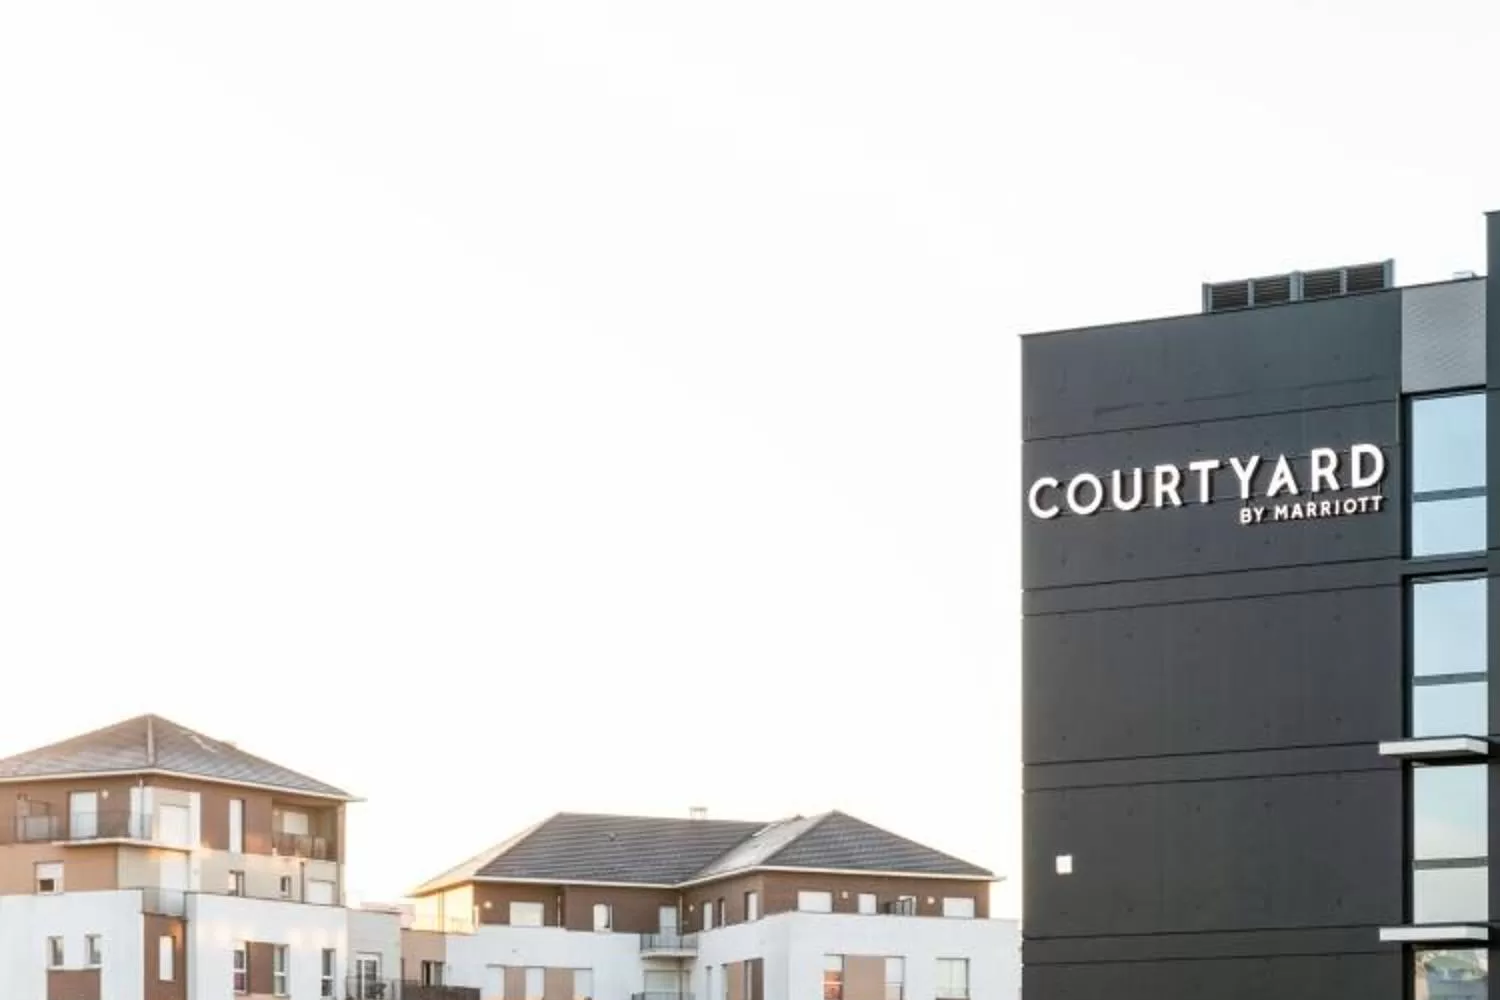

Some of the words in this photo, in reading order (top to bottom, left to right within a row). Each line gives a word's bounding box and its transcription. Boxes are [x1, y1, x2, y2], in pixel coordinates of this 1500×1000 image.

[1028, 443, 1385, 520] COURTYARD
[1240, 507, 1265, 525] BY
[1273, 495, 1384, 521] MARRIOTT
